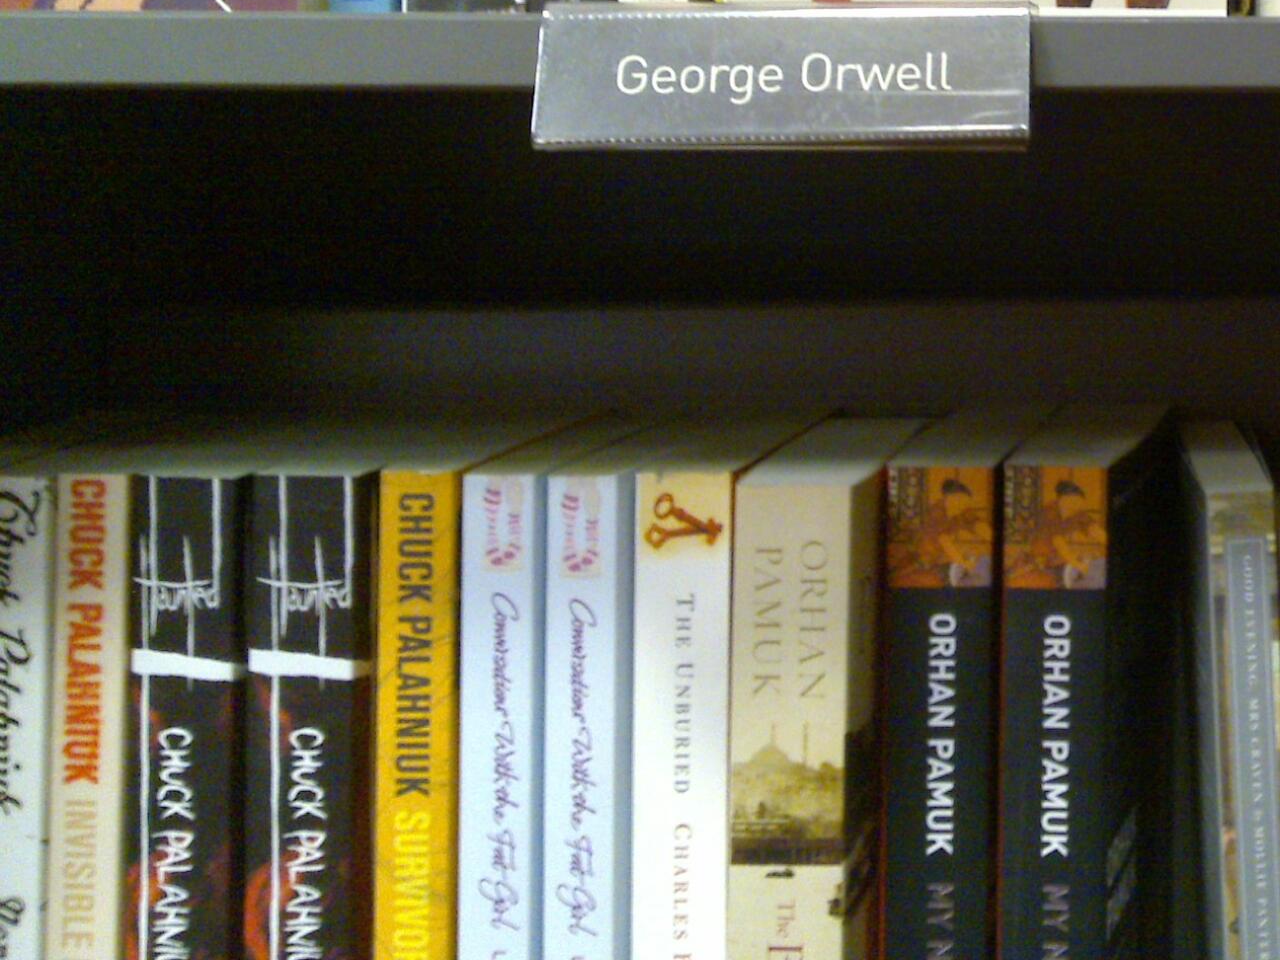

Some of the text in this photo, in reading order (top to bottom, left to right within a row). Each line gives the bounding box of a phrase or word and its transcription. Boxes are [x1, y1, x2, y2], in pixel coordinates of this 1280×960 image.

[616, 52, 952, 105] George Orwell
[62, 478, 106, 948] CHUCK PALAHNIUK INVISIBLE
[394, 492, 434, 797] CHUCK PALAHNIUK
[675, 595, 694, 648] THE
[752, 546, 783, 696] PAMUK
[800, 540, 829, 700] ORHAN
[673, 662, 694, 795] UNBURIED
[926, 613, 957, 857] ORHAN PAMUK
[1040, 614, 1071, 857] ORHAN PAMUK
[151, 727, 194, 960] CHUCK PALAHNI
[283, 727, 327, 960] CHUCK PALAHNI
[672, 823, 693, 942] CHARLES
